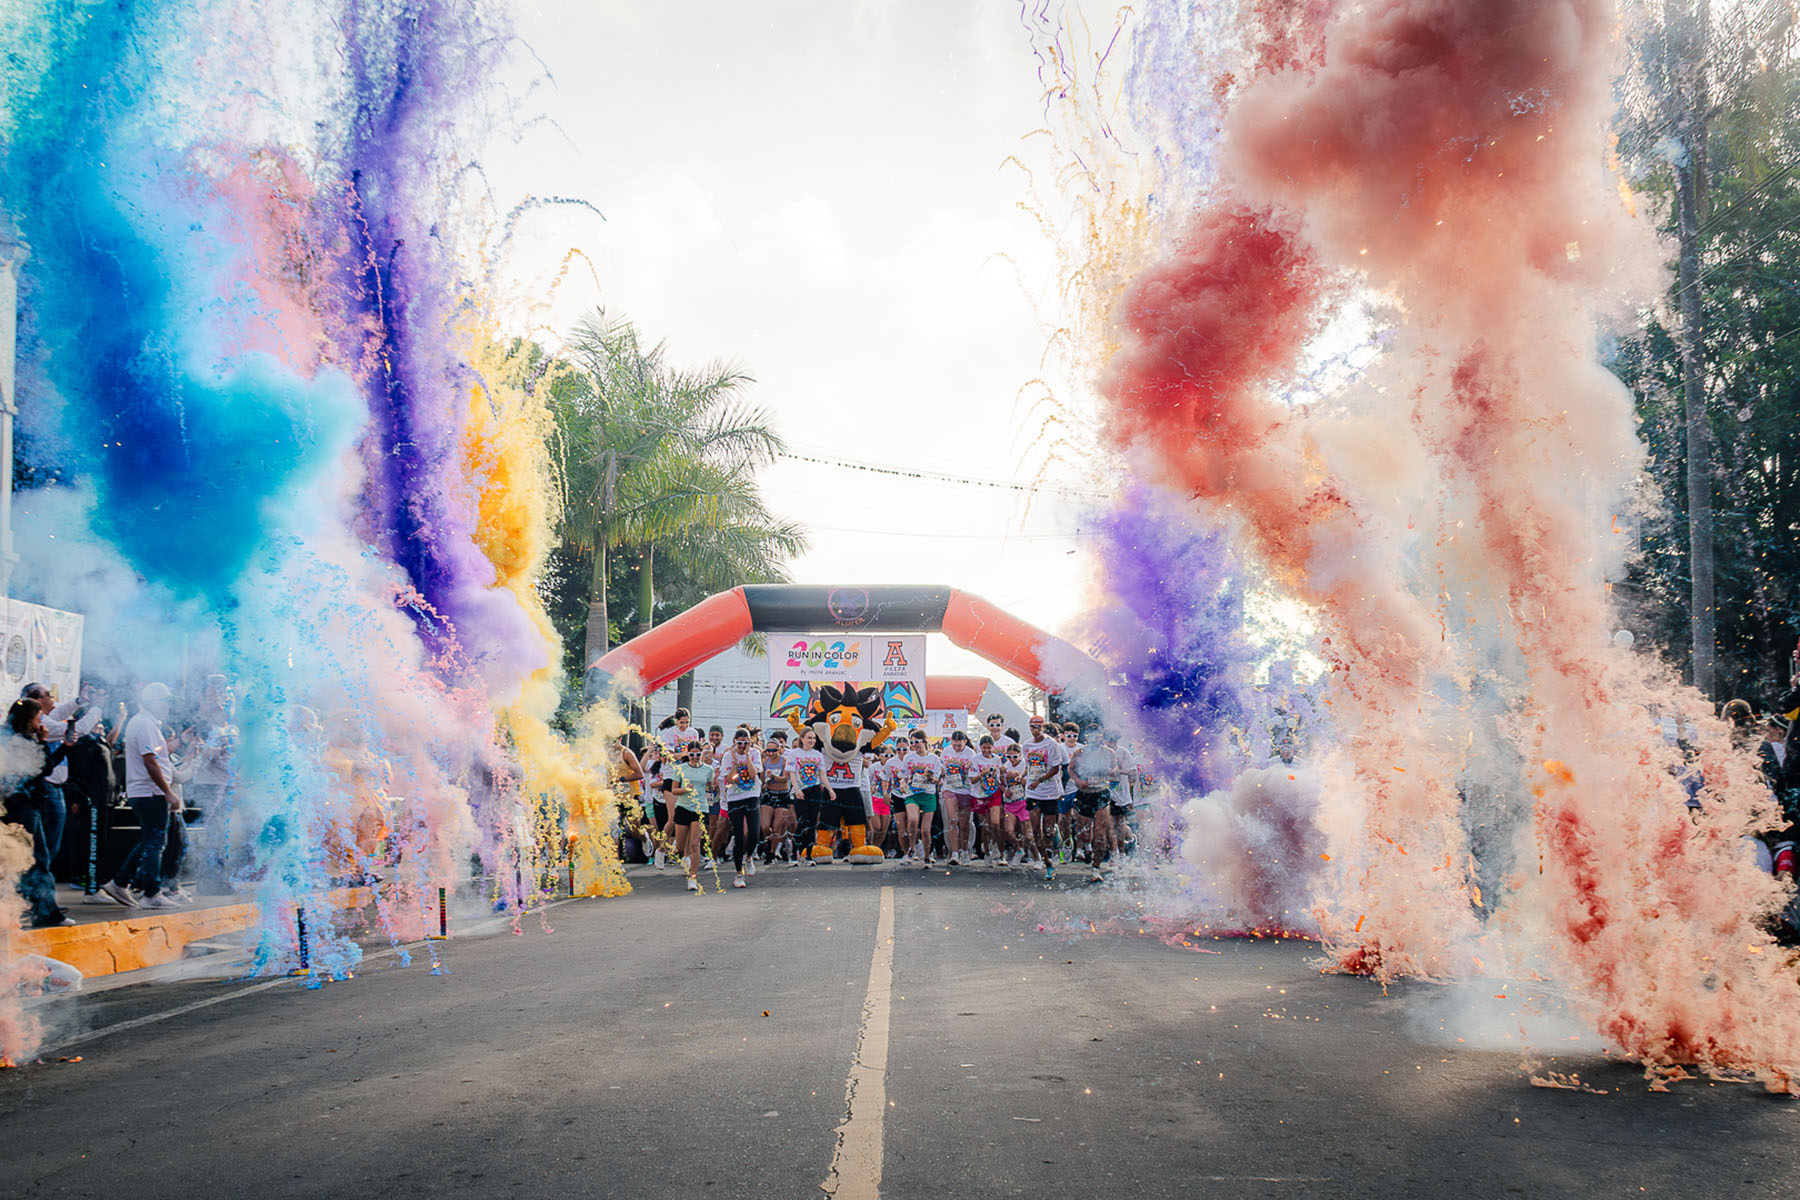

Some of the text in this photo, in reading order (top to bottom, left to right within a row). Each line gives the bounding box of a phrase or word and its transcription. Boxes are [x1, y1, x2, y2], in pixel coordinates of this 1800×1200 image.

[786, 640, 860, 668] 2026
[788, 651, 859, 660] RUN IN COLOR
[883, 641, 908, 666] A
[942, 713, 957, 728] A
